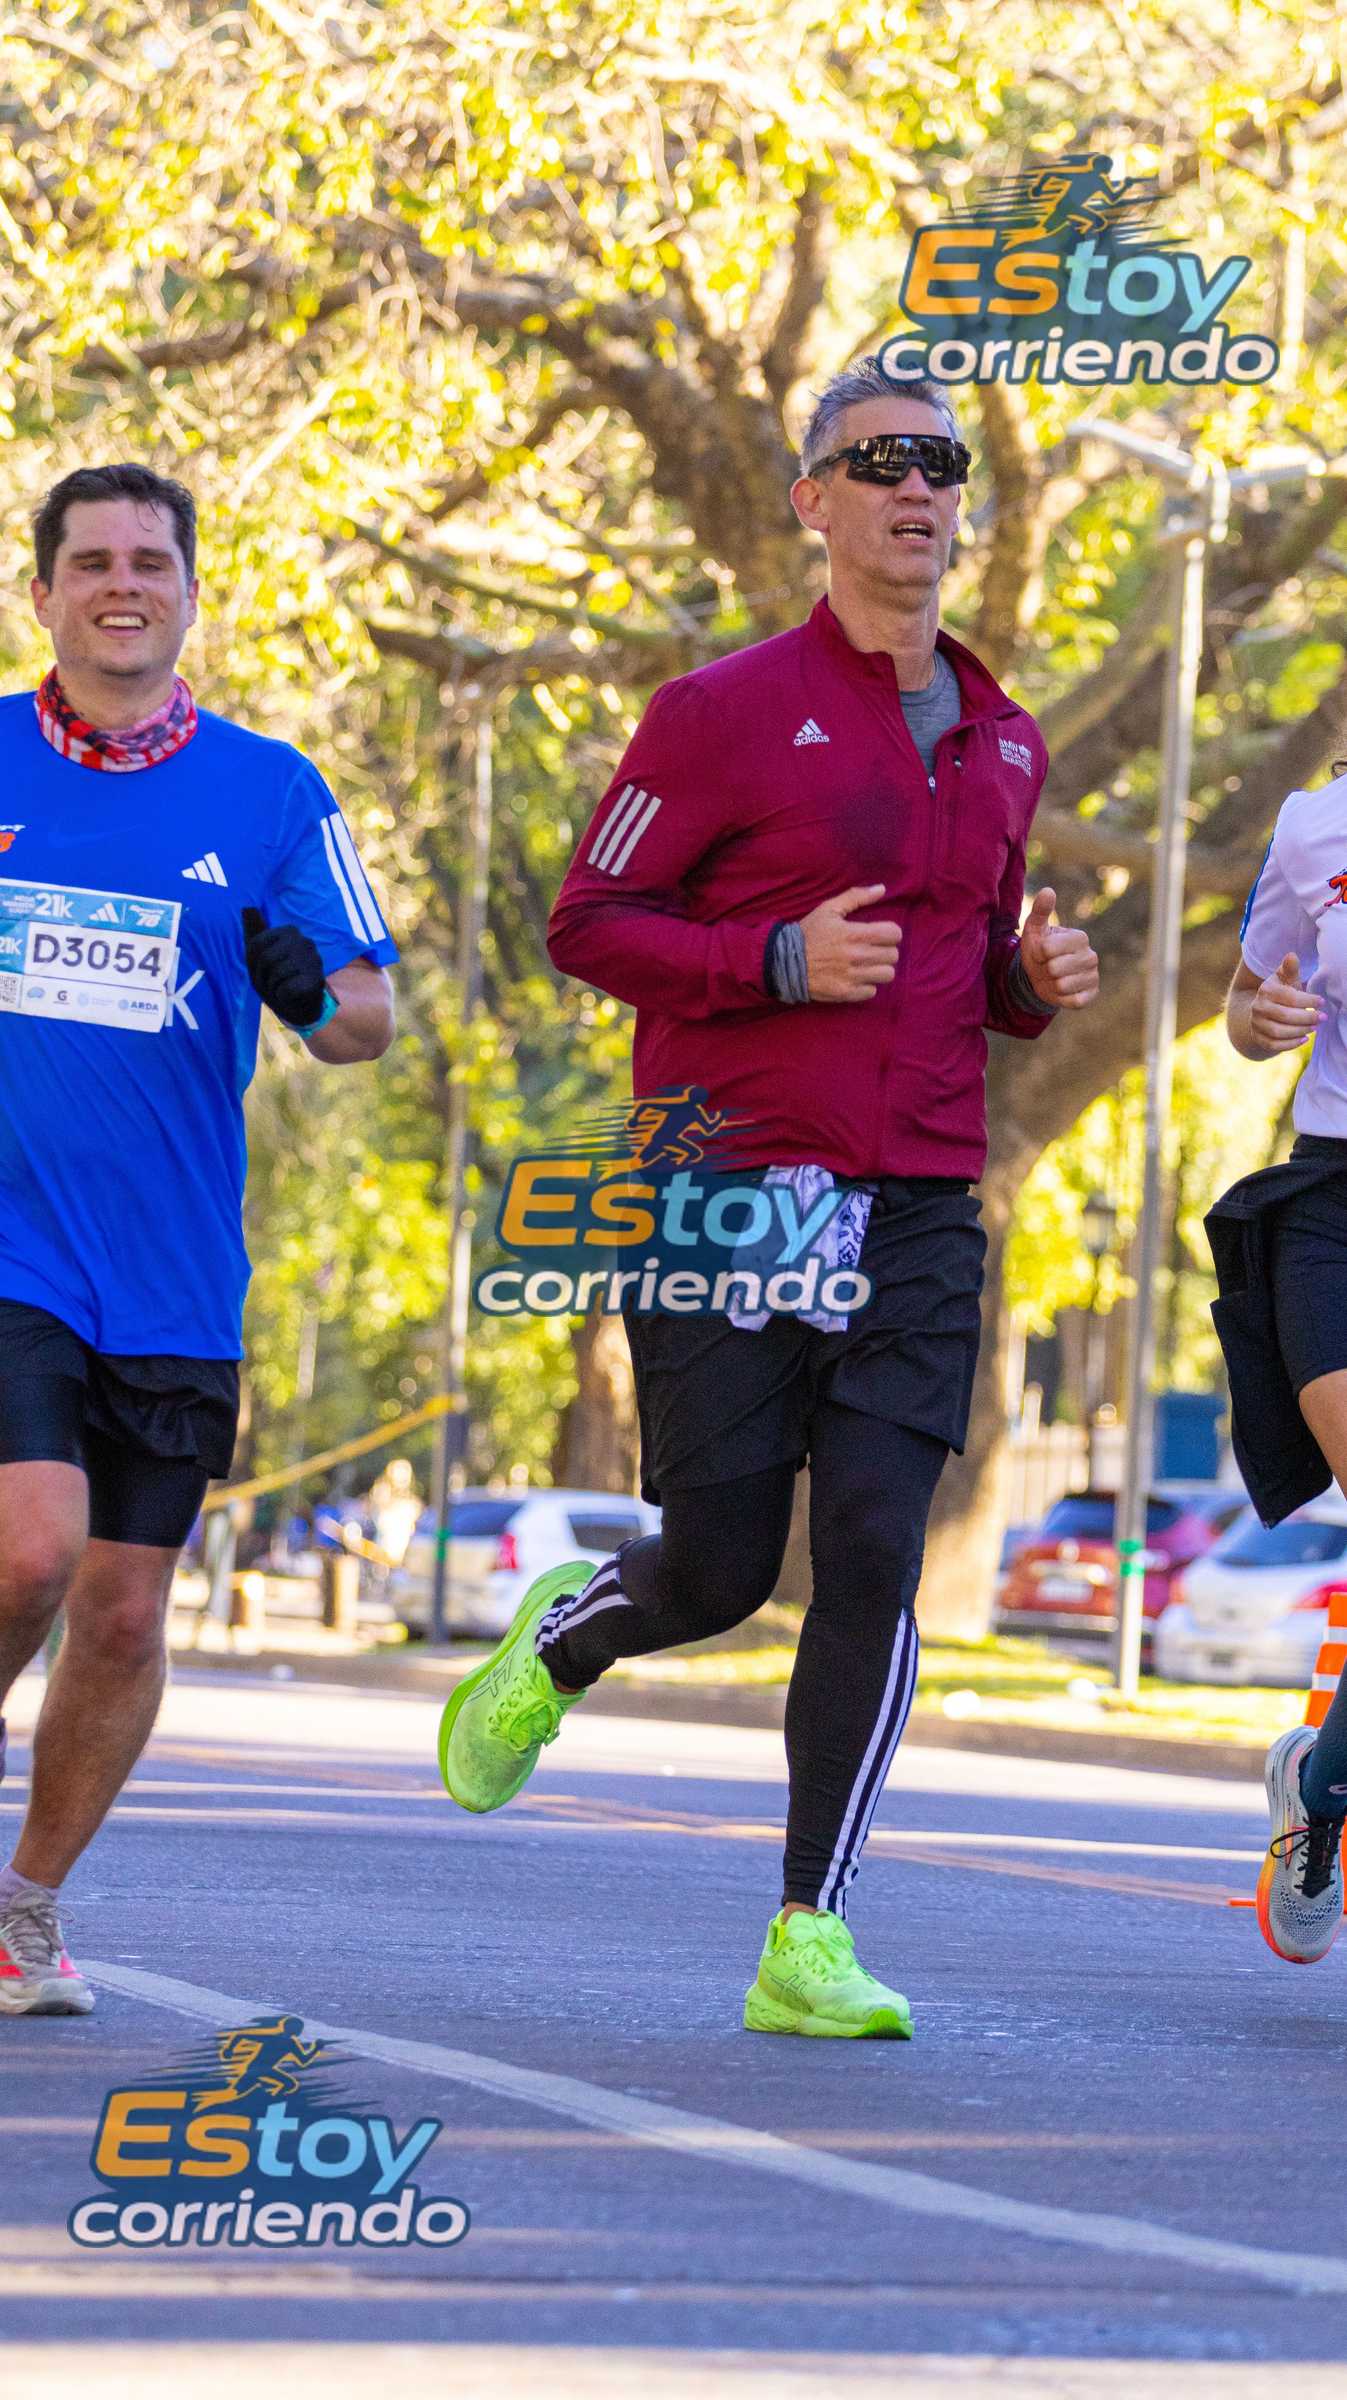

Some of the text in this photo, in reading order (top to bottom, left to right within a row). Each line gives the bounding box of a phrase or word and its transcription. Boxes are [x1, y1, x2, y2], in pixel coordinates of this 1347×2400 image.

[794, 734, 830, 746] adidas
[33, 934, 161, 977] D3054
[57, 990, 68, 1001] G
[130, 1001, 159, 1011] ARDA
